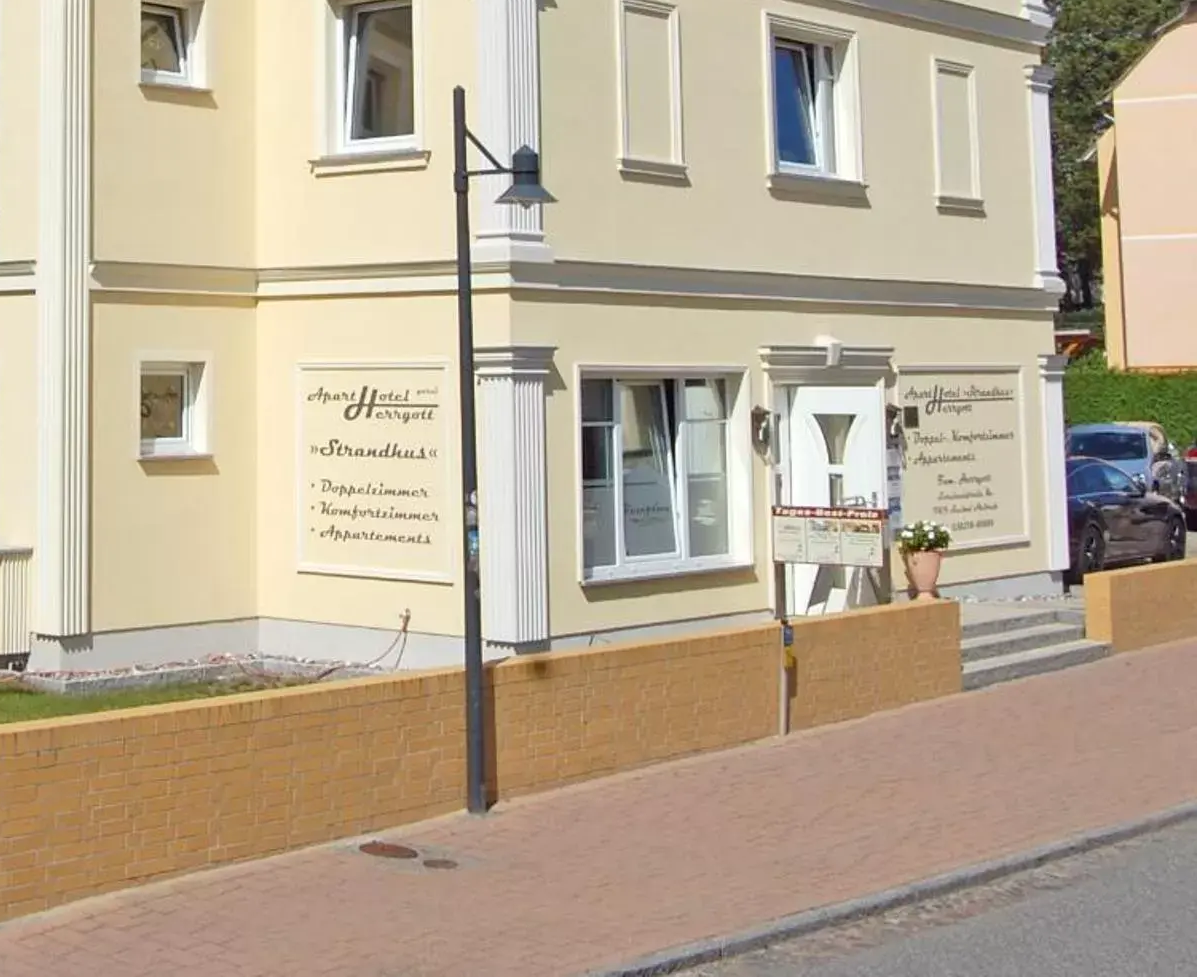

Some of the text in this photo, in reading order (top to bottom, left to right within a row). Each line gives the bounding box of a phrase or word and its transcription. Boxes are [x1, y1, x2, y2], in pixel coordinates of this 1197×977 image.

[321, 478, 429, 499] Doppelzimmer
[319, 500, 440, 522] Komfortzimmer
[320, 524, 432, 545] Appartements
